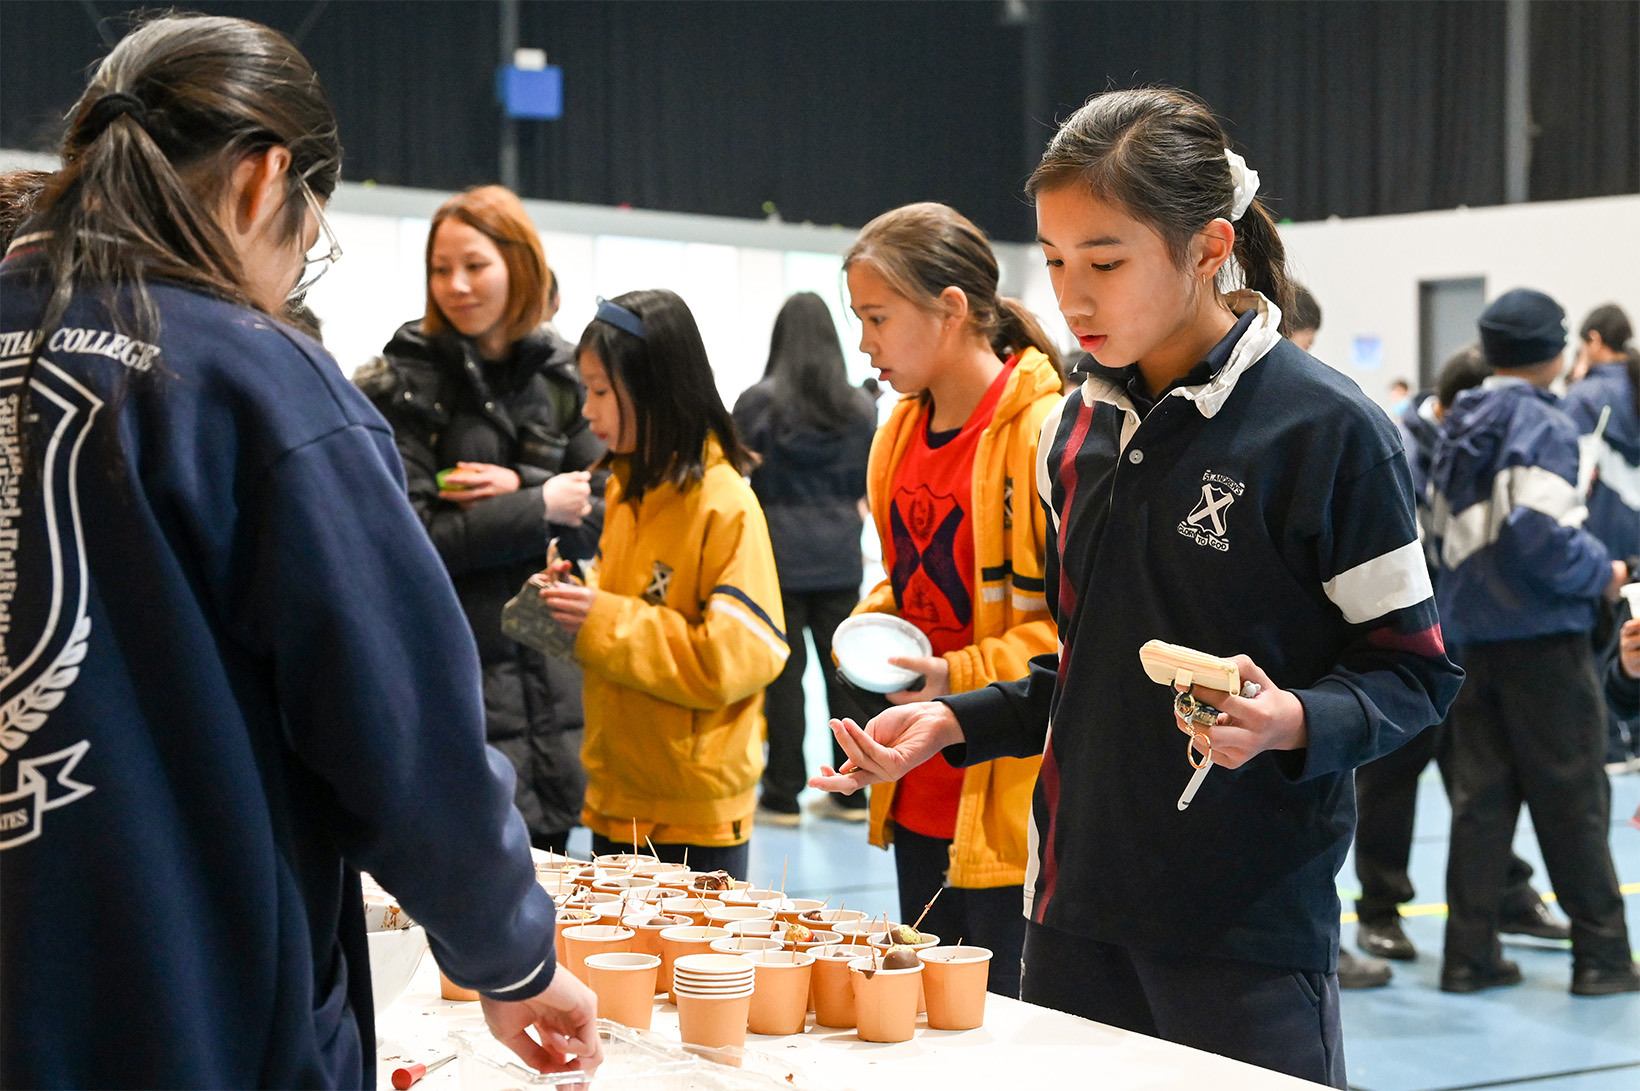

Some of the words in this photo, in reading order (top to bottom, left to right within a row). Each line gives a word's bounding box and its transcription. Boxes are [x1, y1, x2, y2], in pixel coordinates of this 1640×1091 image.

[48, 327, 161, 372] COLLEGE
[1197, 536, 1206, 545] TO
[1210, 539, 1227, 550] GOD
